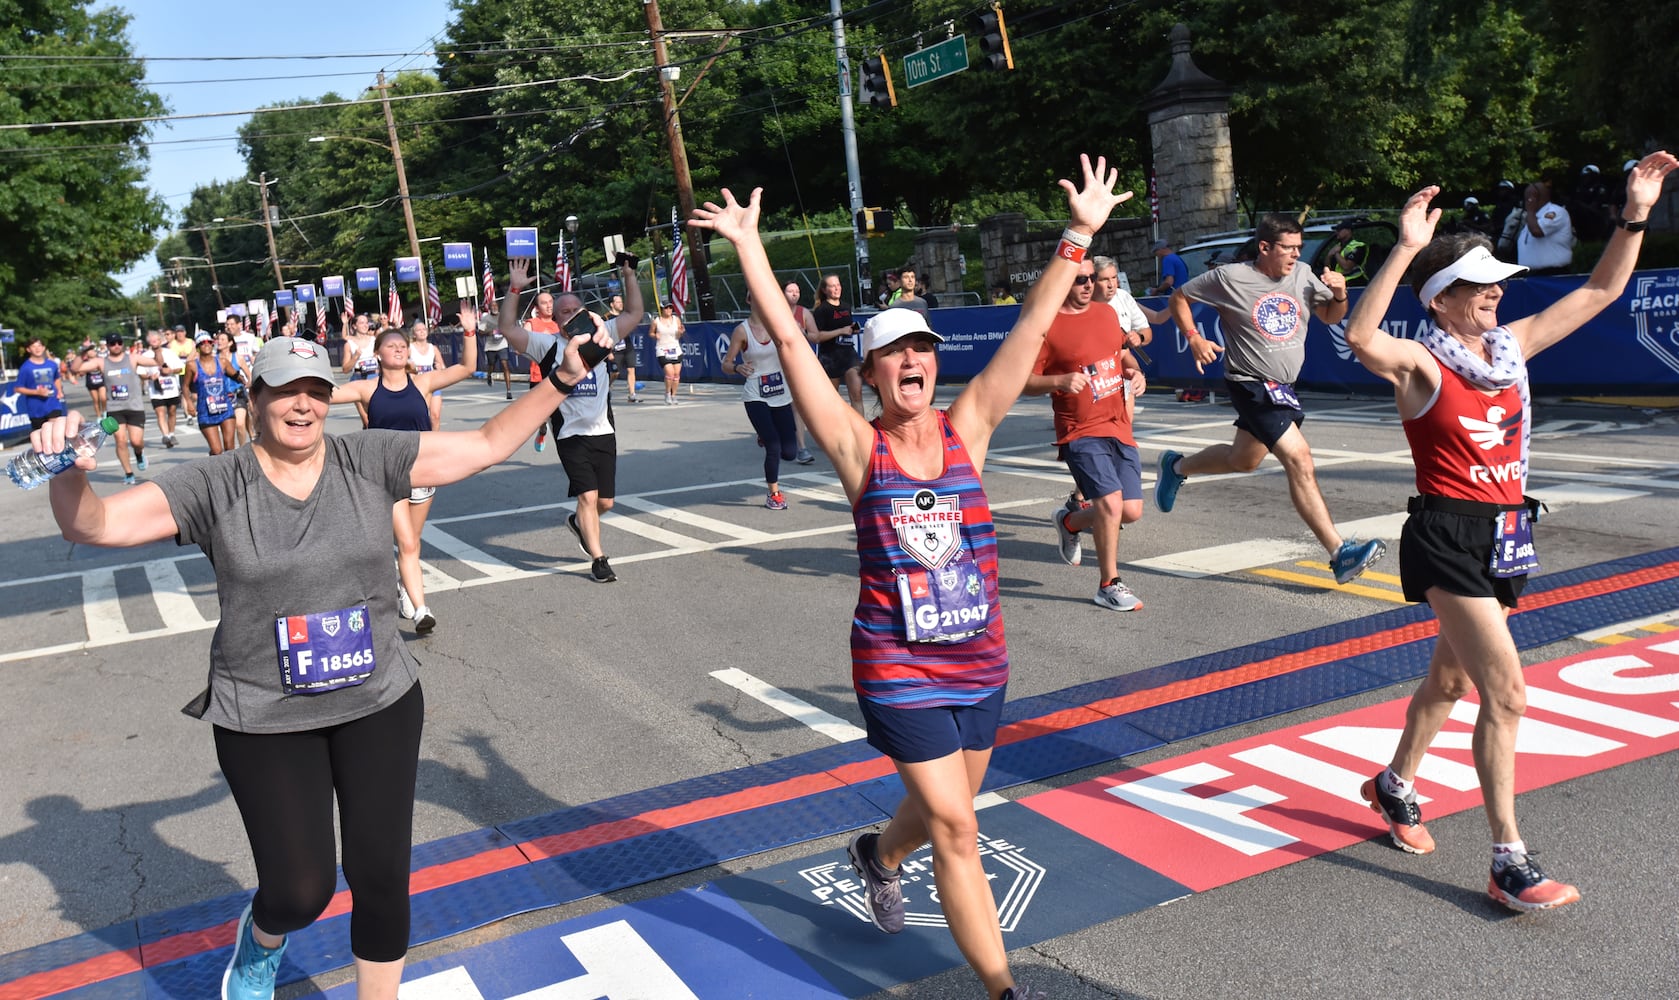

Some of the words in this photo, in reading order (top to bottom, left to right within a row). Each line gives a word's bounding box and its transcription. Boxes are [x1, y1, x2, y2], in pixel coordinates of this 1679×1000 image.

[907, 57, 928, 81] 10th
[929, 52, 941, 73] St
[951, 332, 973, 342] Atlanta
[973, 332, 987, 341] Area
[987, 331, 1004, 341] BMW
[938, 343, 974, 352] BMWatl.com
[577, 383, 597, 391] 14741
[762, 384, 770, 394] G
[1093, 377, 1106, 391] H
[1274, 389, 1284, 400] E
[1469, 460, 1521, 484] RWB
[918, 496, 934, 506] AJC
[892, 512, 961, 527] PEACHTREE
[1503, 540, 1515, 562] E
[915, 604, 939, 630] G
[940, 603, 989, 627] 21947
[296, 650, 313, 675] F
[321, 648, 374, 673] 18565
[1105, 640, 1679, 857] FINIS
[1388, 771, 1405, 789] USA
